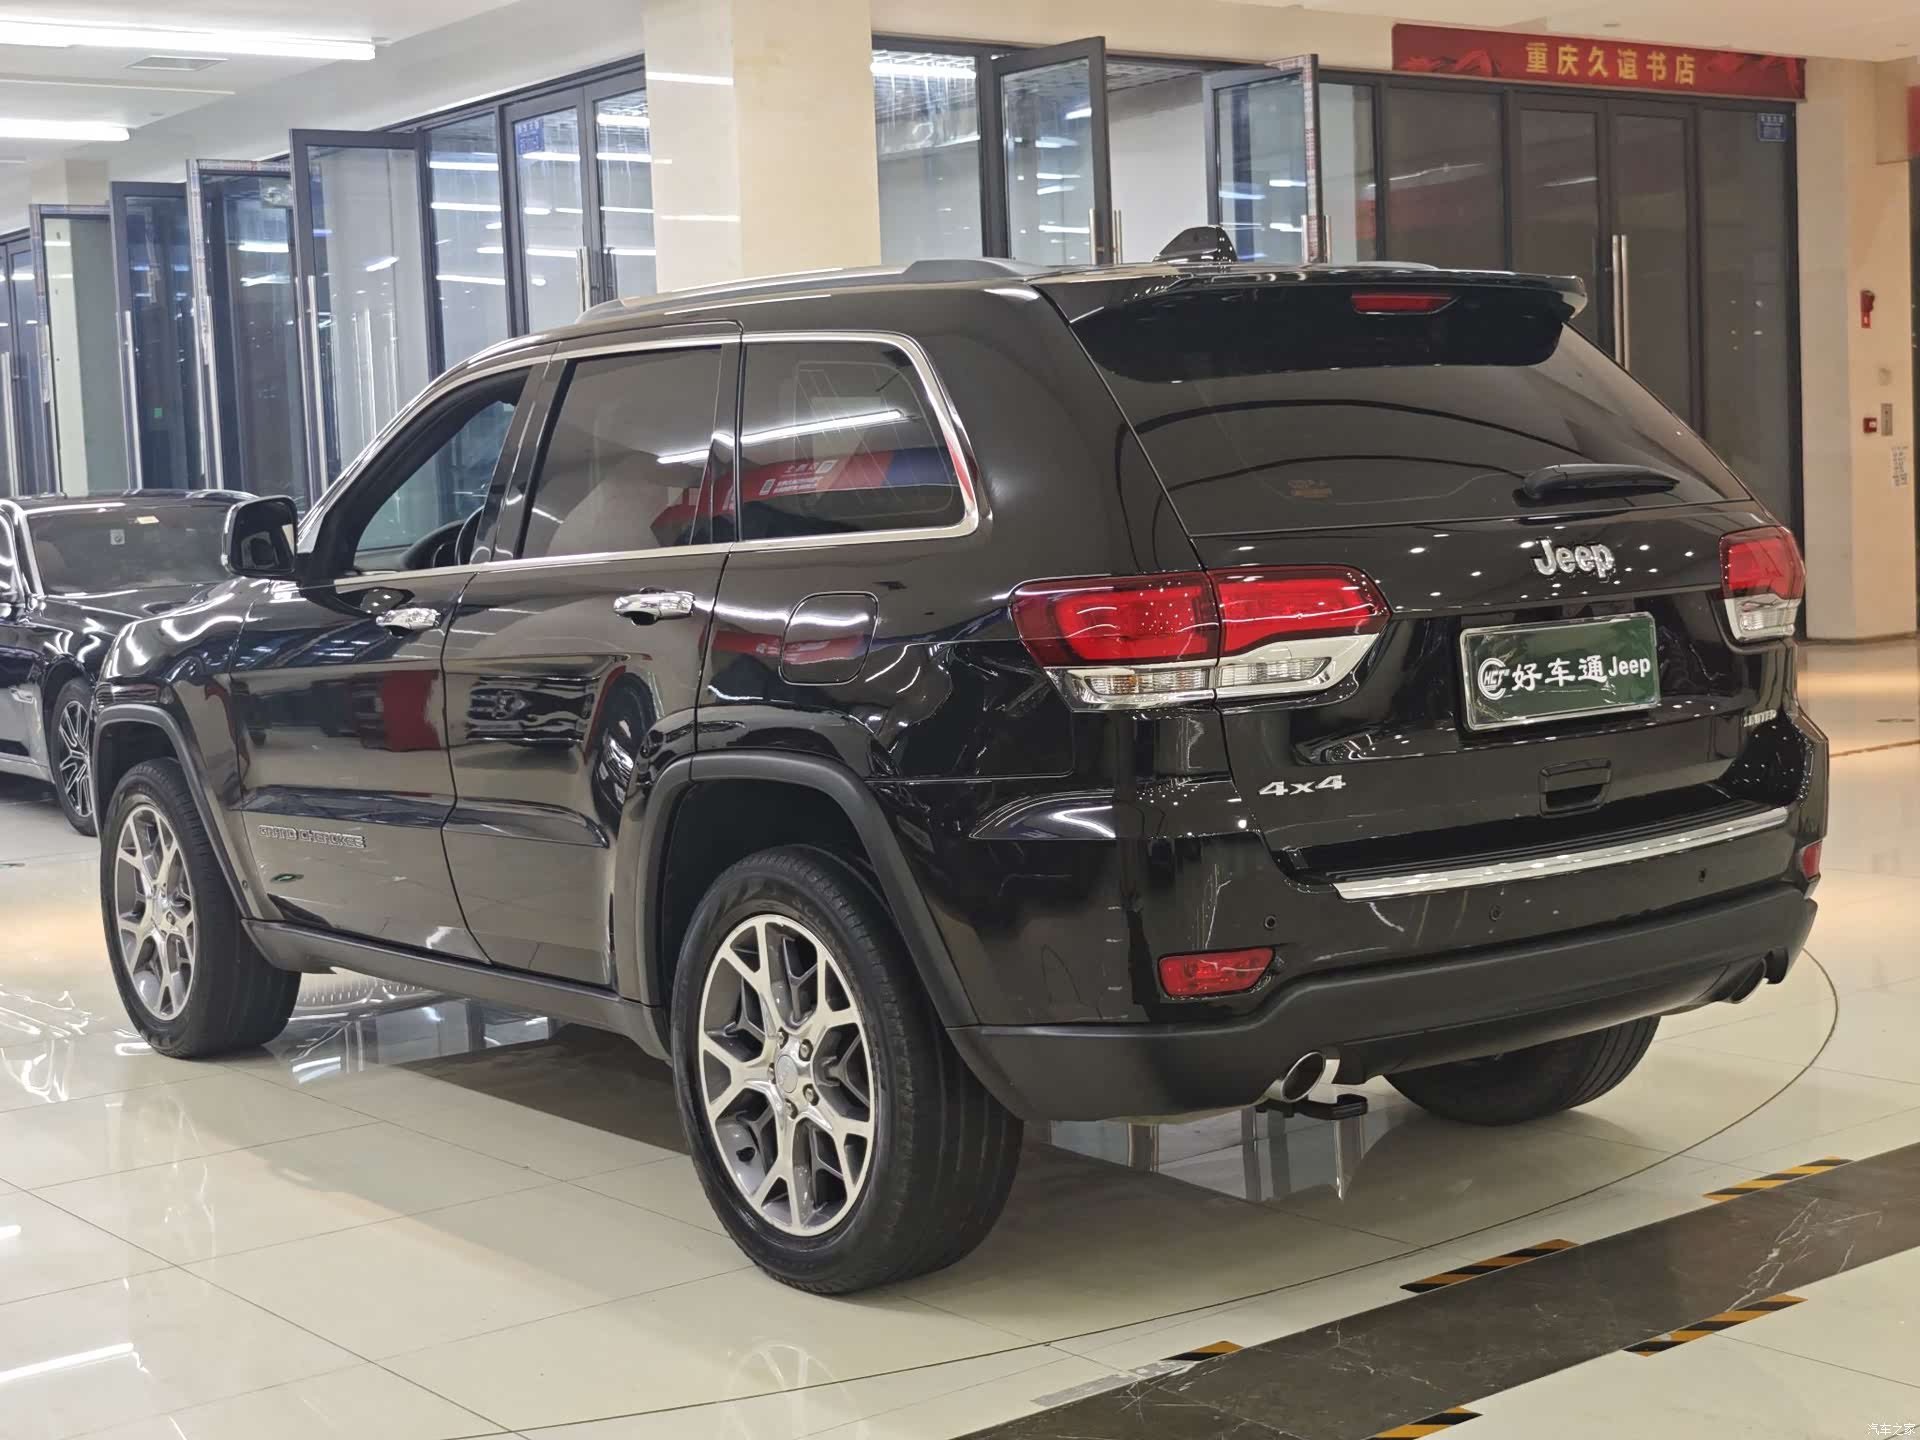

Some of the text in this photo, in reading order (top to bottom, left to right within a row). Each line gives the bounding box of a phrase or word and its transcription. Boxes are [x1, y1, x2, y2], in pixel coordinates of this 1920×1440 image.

[1525, 42, 1696, 84] 重庆久谊书店
[1533, 538, 1615, 580] Jeep
[1259, 775, 1346, 796] 4x4
